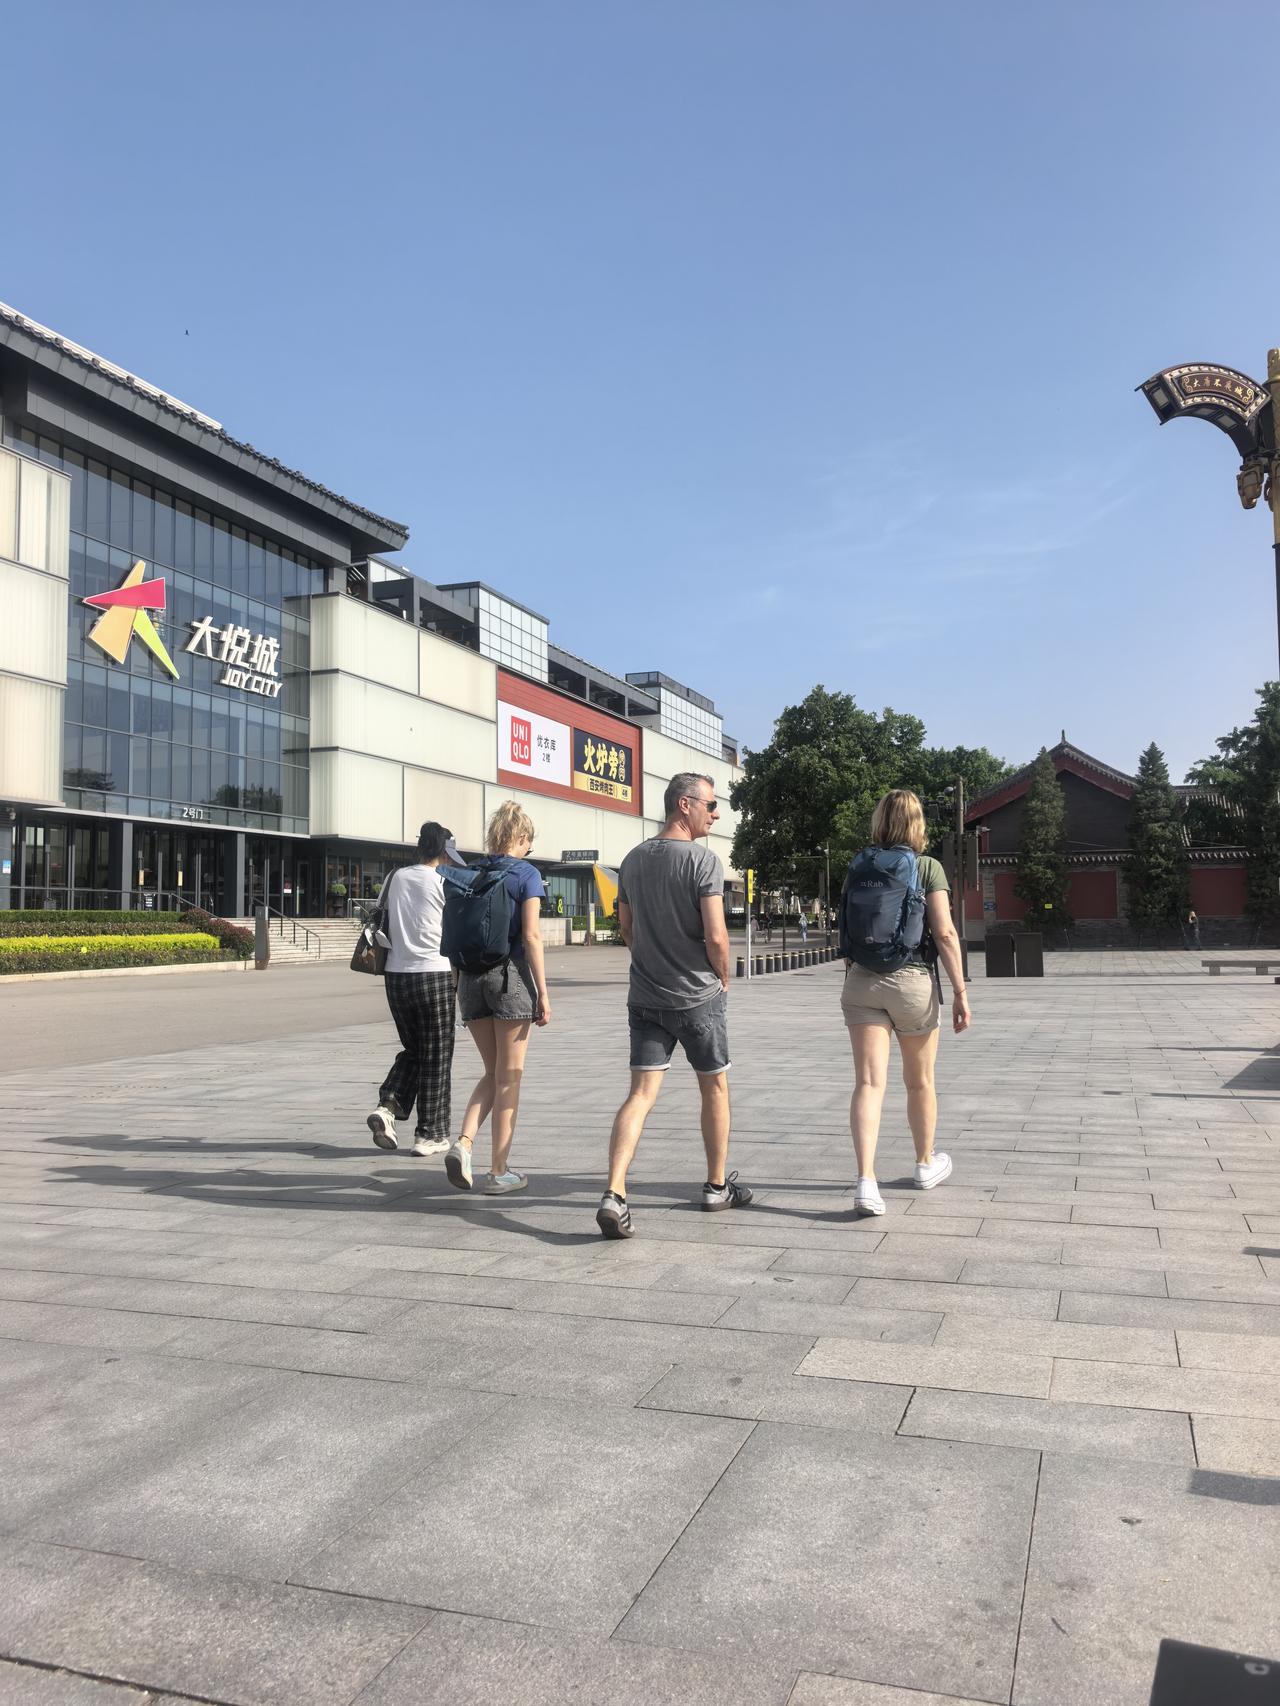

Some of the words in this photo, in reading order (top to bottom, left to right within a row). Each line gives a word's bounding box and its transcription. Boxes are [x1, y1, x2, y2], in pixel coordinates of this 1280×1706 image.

[185, 616, 280, 676] 大悦城
[220, 668, 251, 690] JOY
[250, 676, 284, 697] CITY
[513, 723, 528, 741] UNI
[513, 742, 529, 760] QLO
[537, 735, 556, 751] 优衣库
[542, 752, 550, 763] 2楼
[583, 738, 619, 780] 火炉旁
[183, 807, 204, 819] 2号门
[867, 880, 883, 888] Rab
